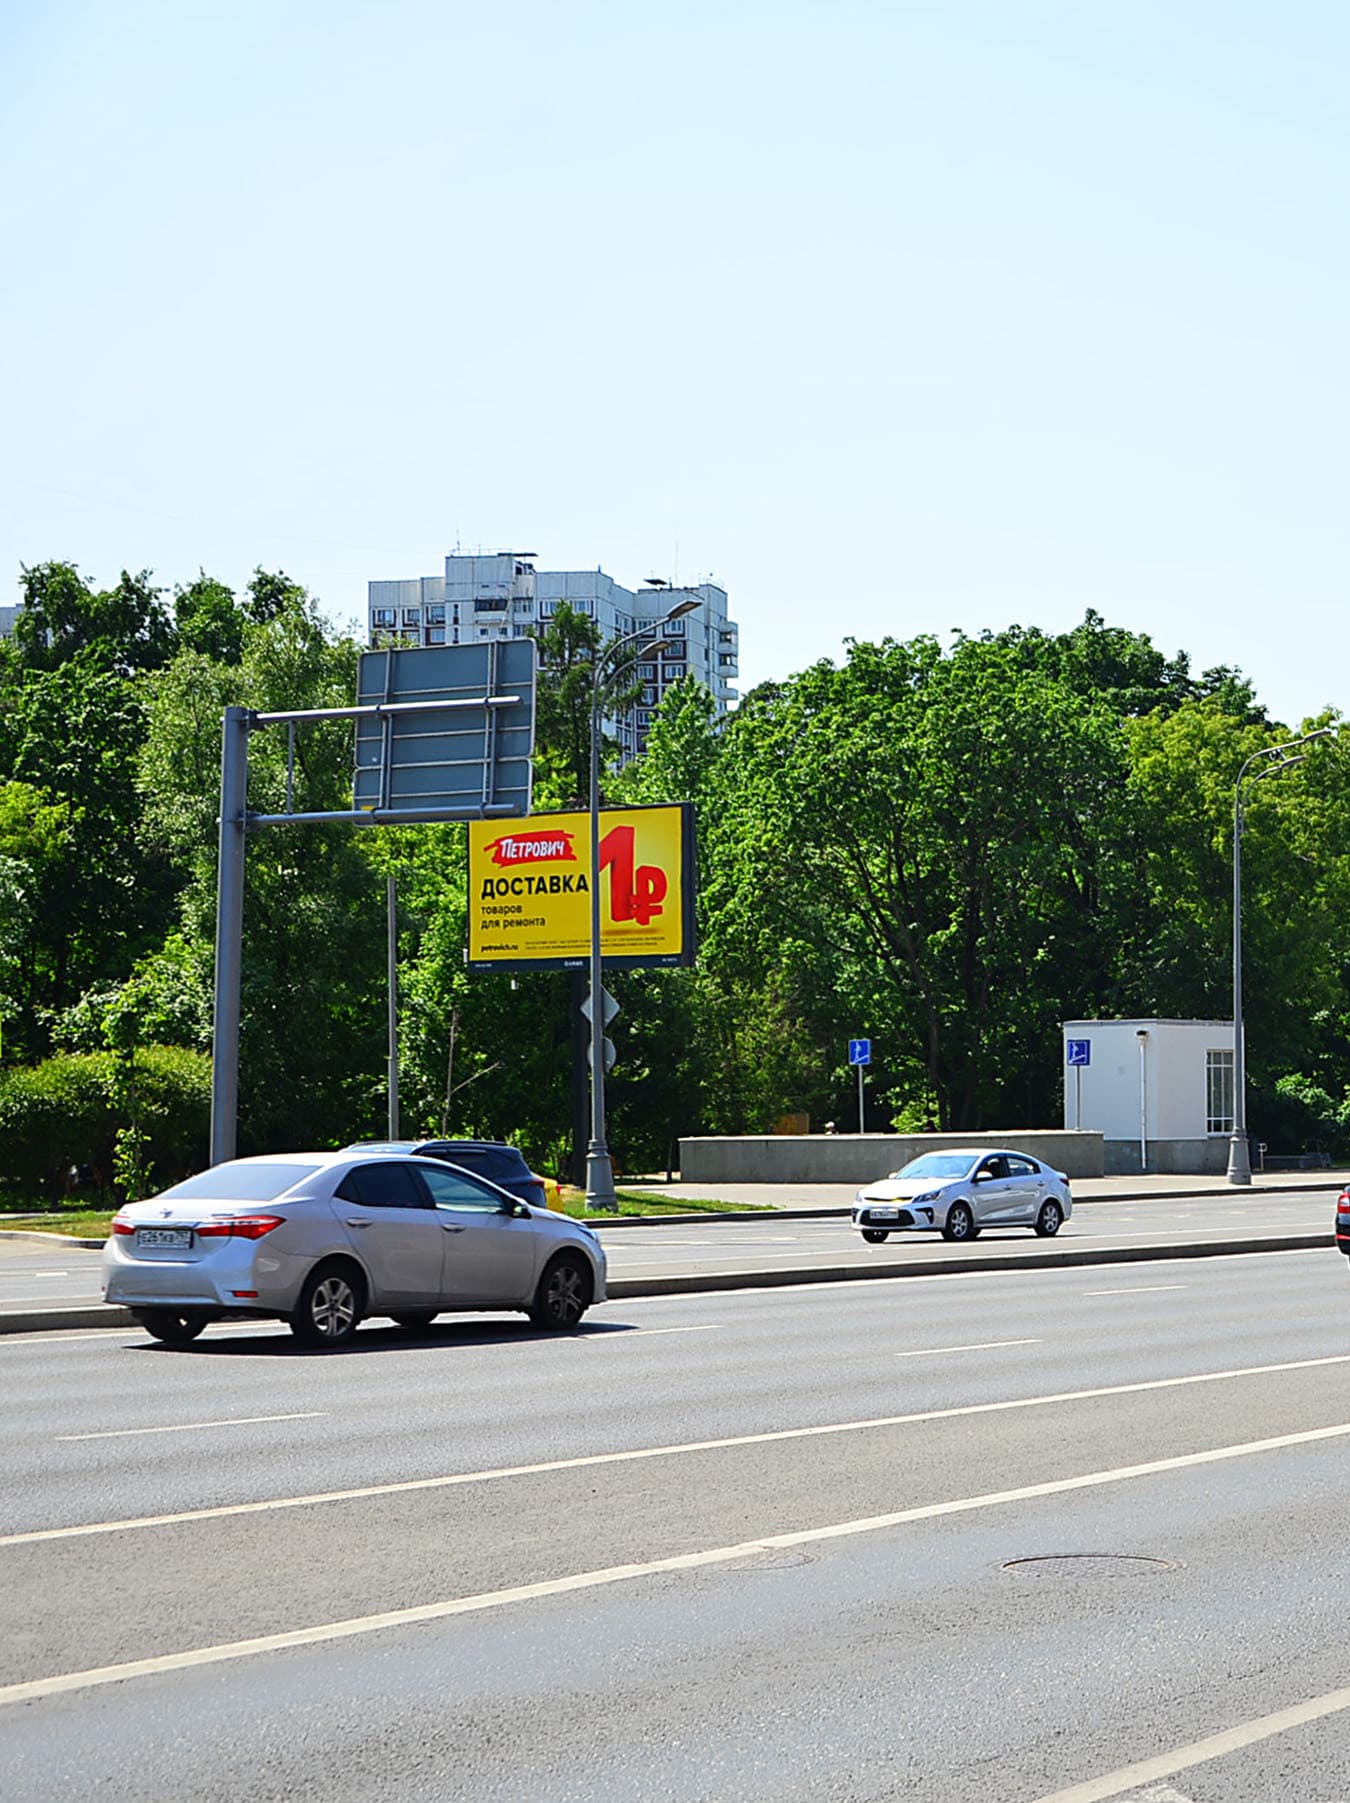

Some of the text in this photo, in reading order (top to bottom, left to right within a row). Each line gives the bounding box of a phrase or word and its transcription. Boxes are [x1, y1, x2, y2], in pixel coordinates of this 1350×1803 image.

[481, 874, 589, 900] ДОСТАВКА
[481, 904, 522, 916] товаров
[481, 915, 546, 931] для ремонта
